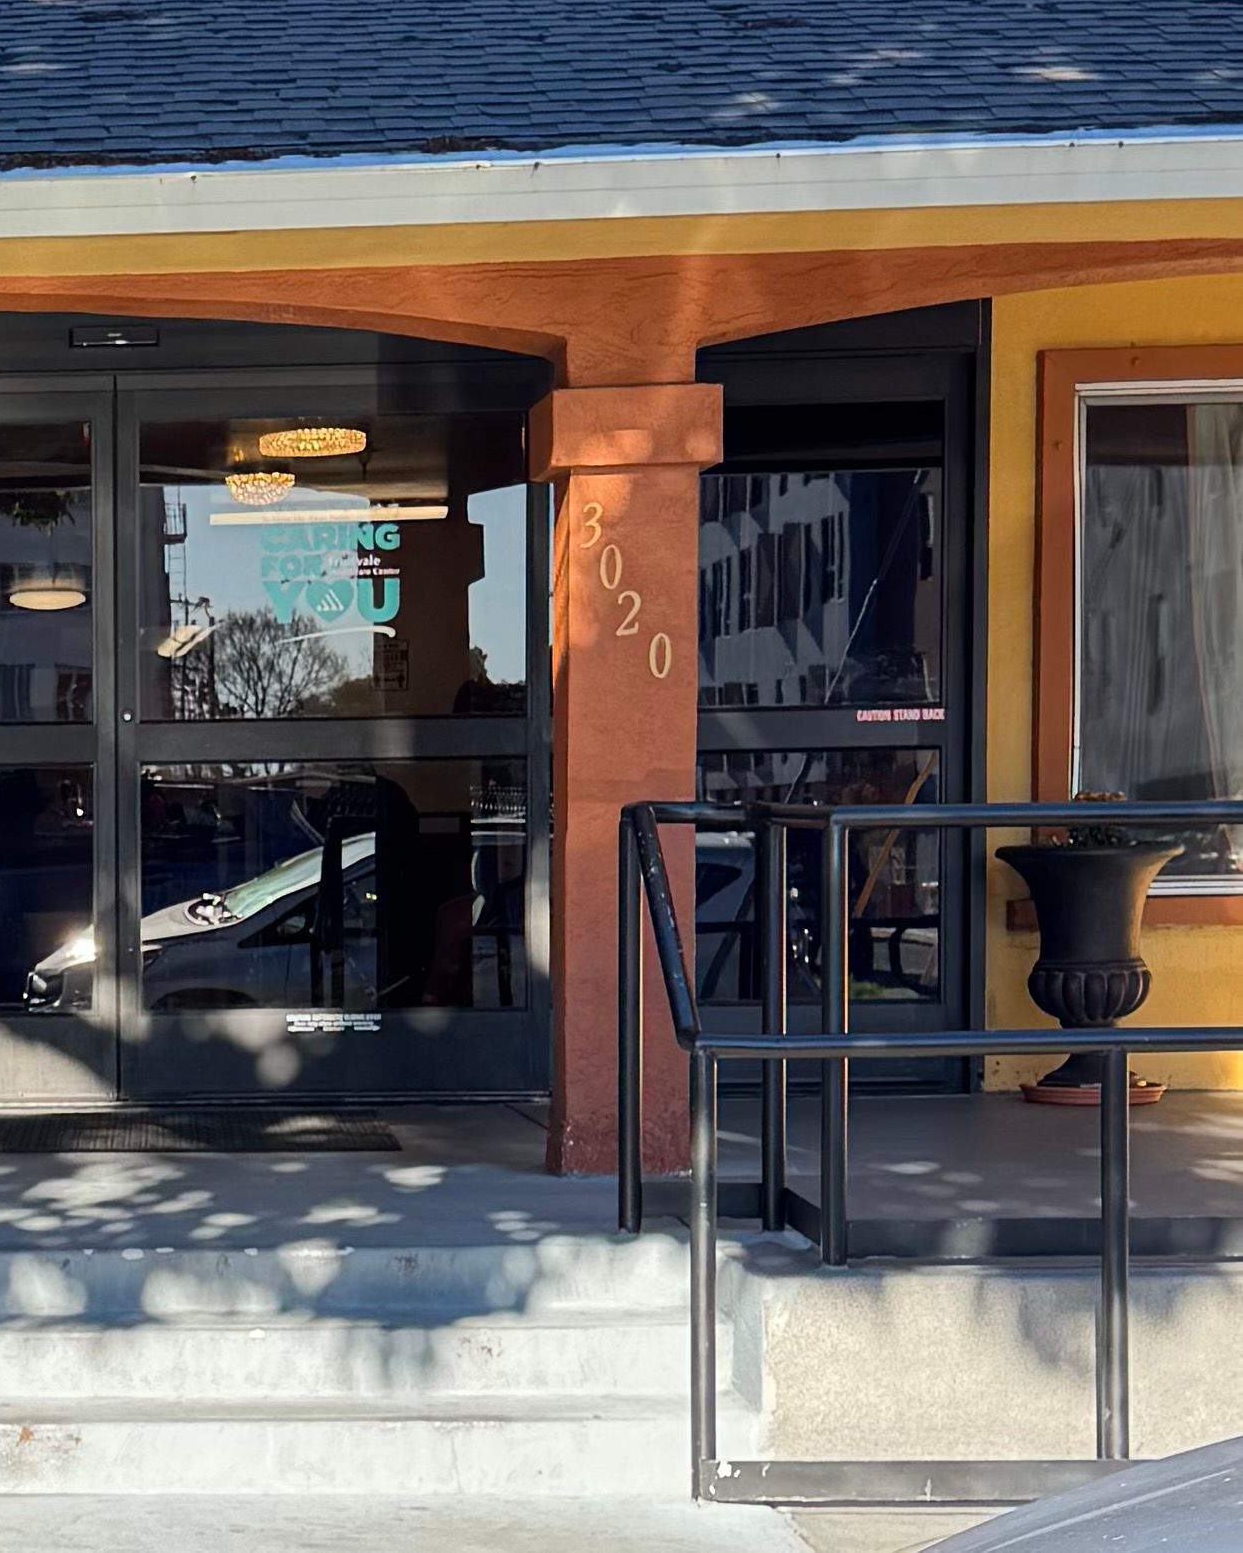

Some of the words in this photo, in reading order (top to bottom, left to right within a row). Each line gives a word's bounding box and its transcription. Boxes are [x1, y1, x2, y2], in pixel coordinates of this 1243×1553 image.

[261, 522, 401, 551] CARING
[261, 554, 322, 578] FOR
[580, 502, 672, 678] 3020
[892, 708, 920, 721] STAND
